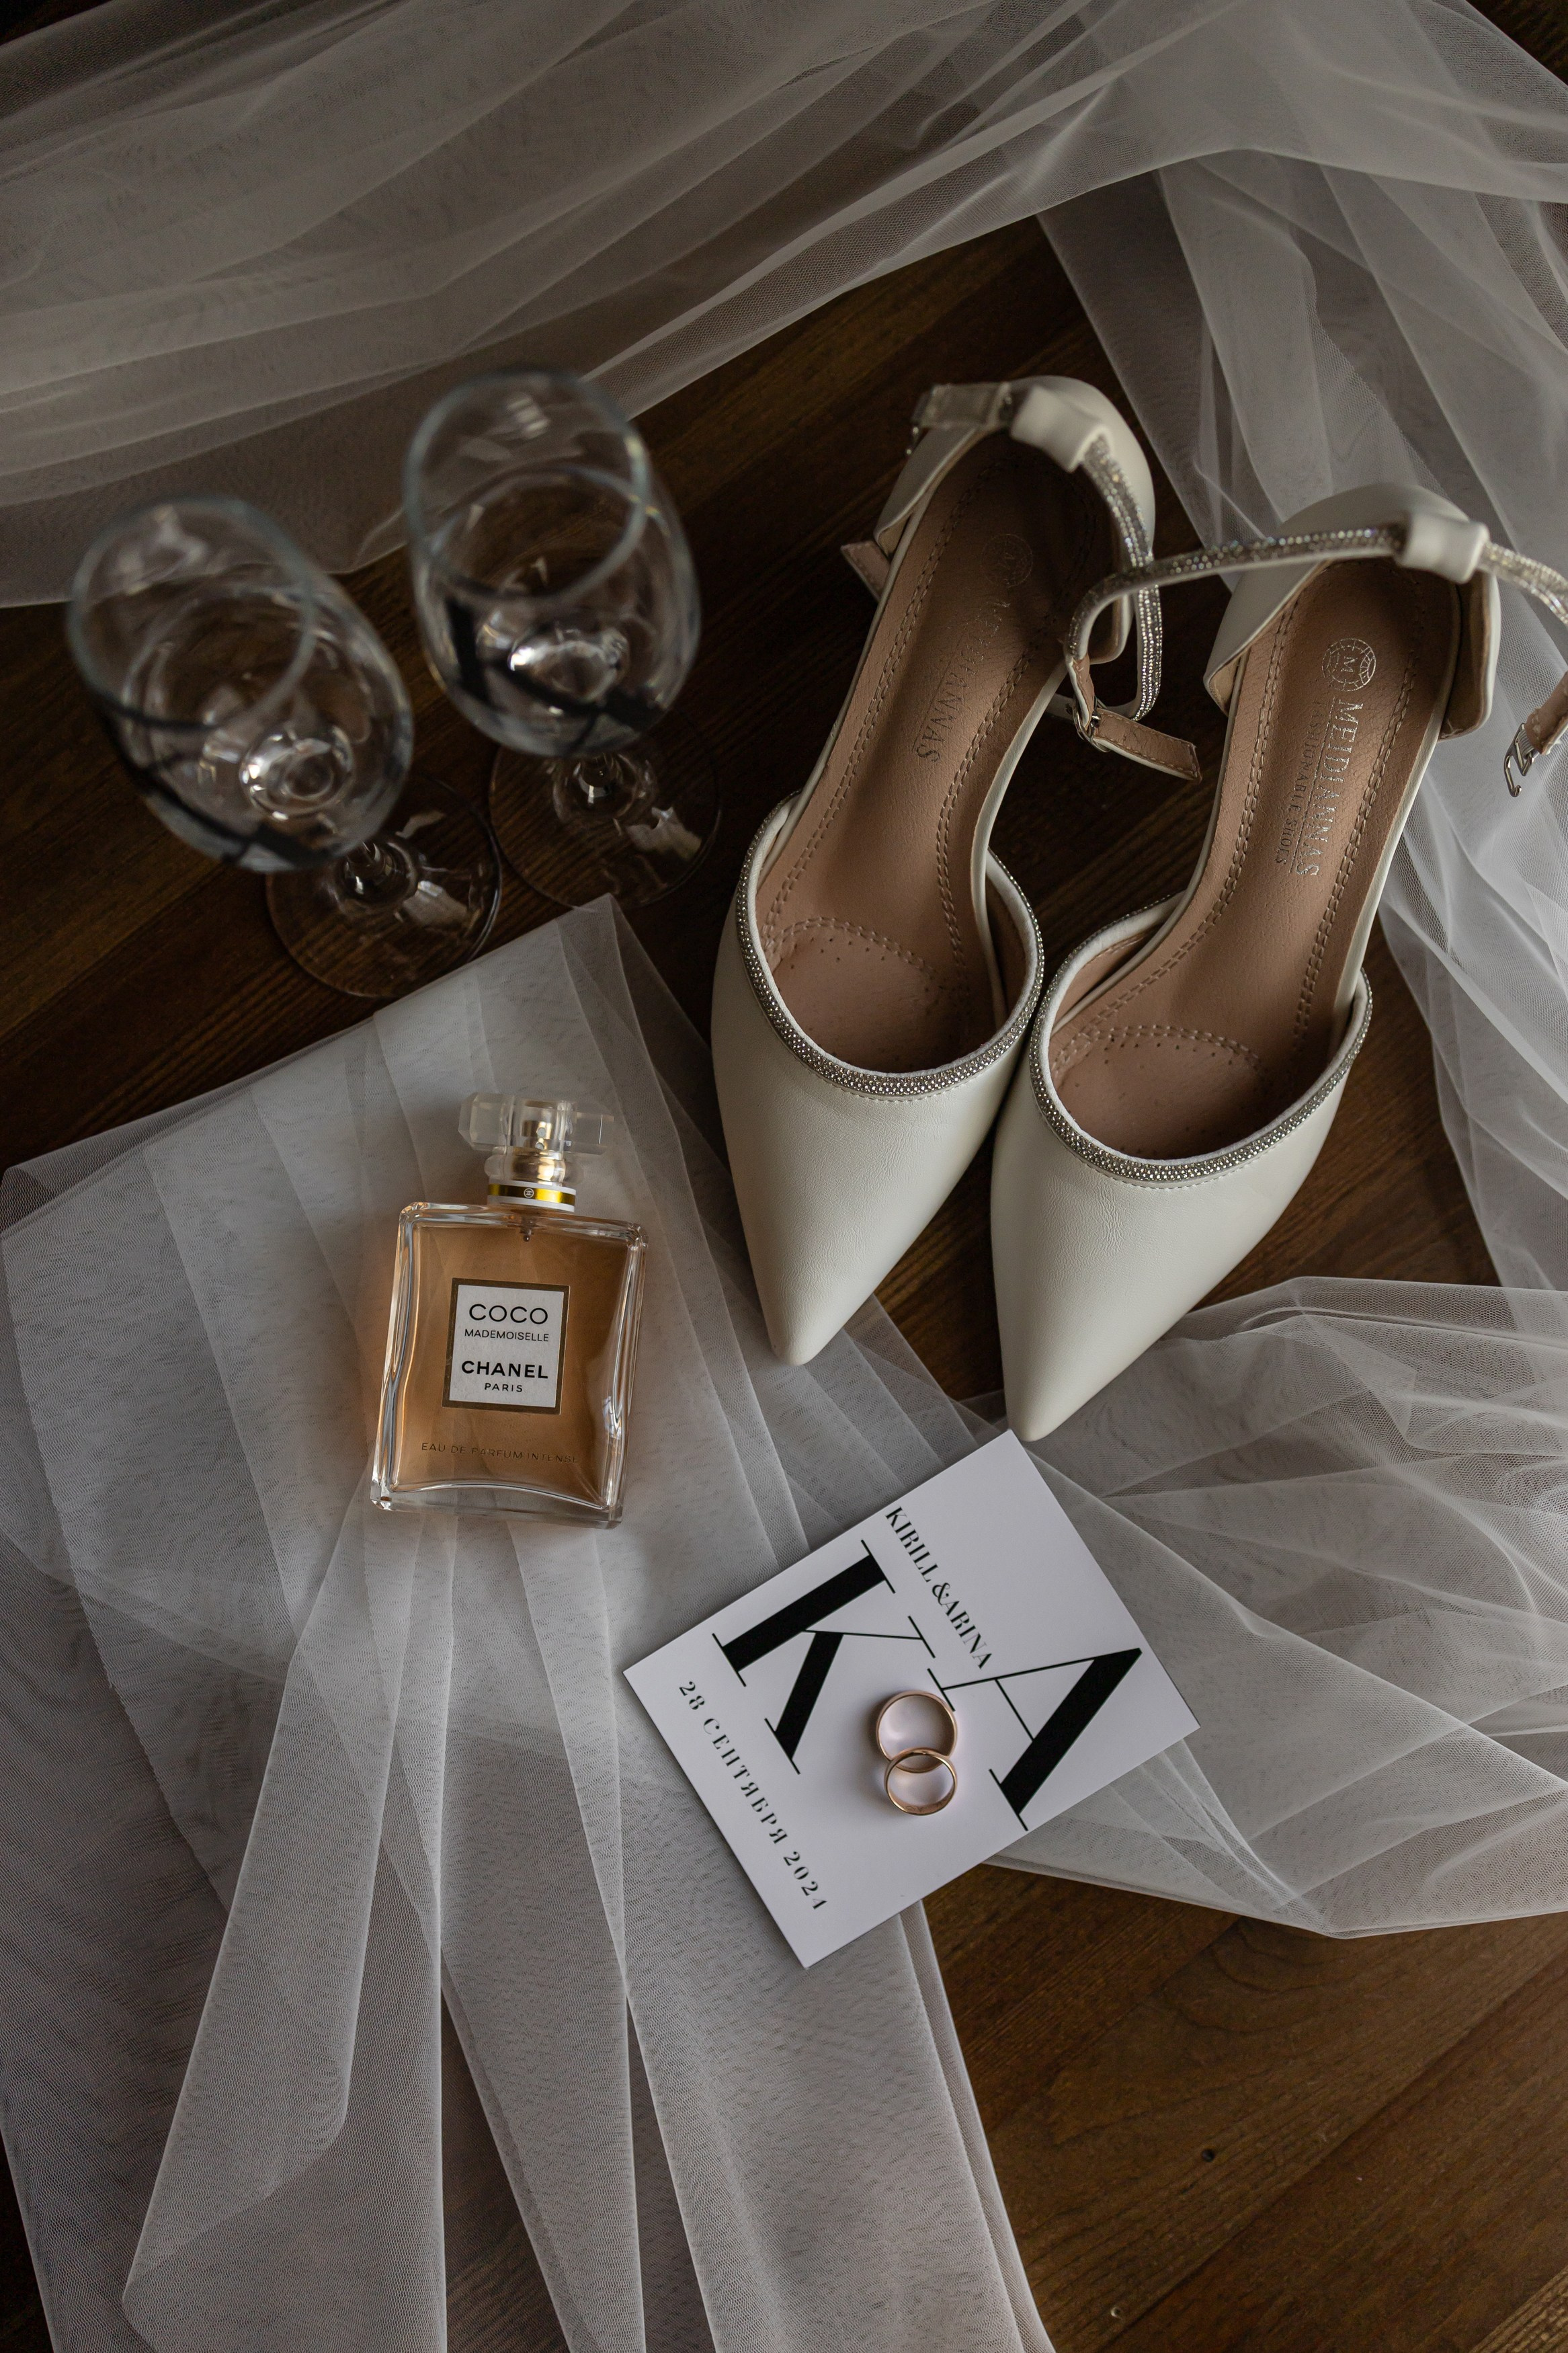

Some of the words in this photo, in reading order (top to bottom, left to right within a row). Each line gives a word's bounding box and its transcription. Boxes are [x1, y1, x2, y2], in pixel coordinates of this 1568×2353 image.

[1296, 699, 1364, 875] MEIDIANNAS
[1274, 818, 1298, 865] SHOES
[468, 1304, 548, 1324] COCO
[464, 1328, 549, 1342] MADEMOISELLE
[461, 1360, 548, 1379] CHANEL
[484, 1383, 523, 1392] PARIS
[421, 1442, 446, 1452] EAU
[451, 1445, 466, 1453] DE
[471, 1447, 523, 1459] PARFUM
[712, 1540, 935, 1774] K
[927, 1647, 1143, 1831] A
[679, 1681, 705, 1710] 28
[703, 1718, 788, 1844] СЕНТЯБРЯ
[783, 1851, 827, 1910] 2024
